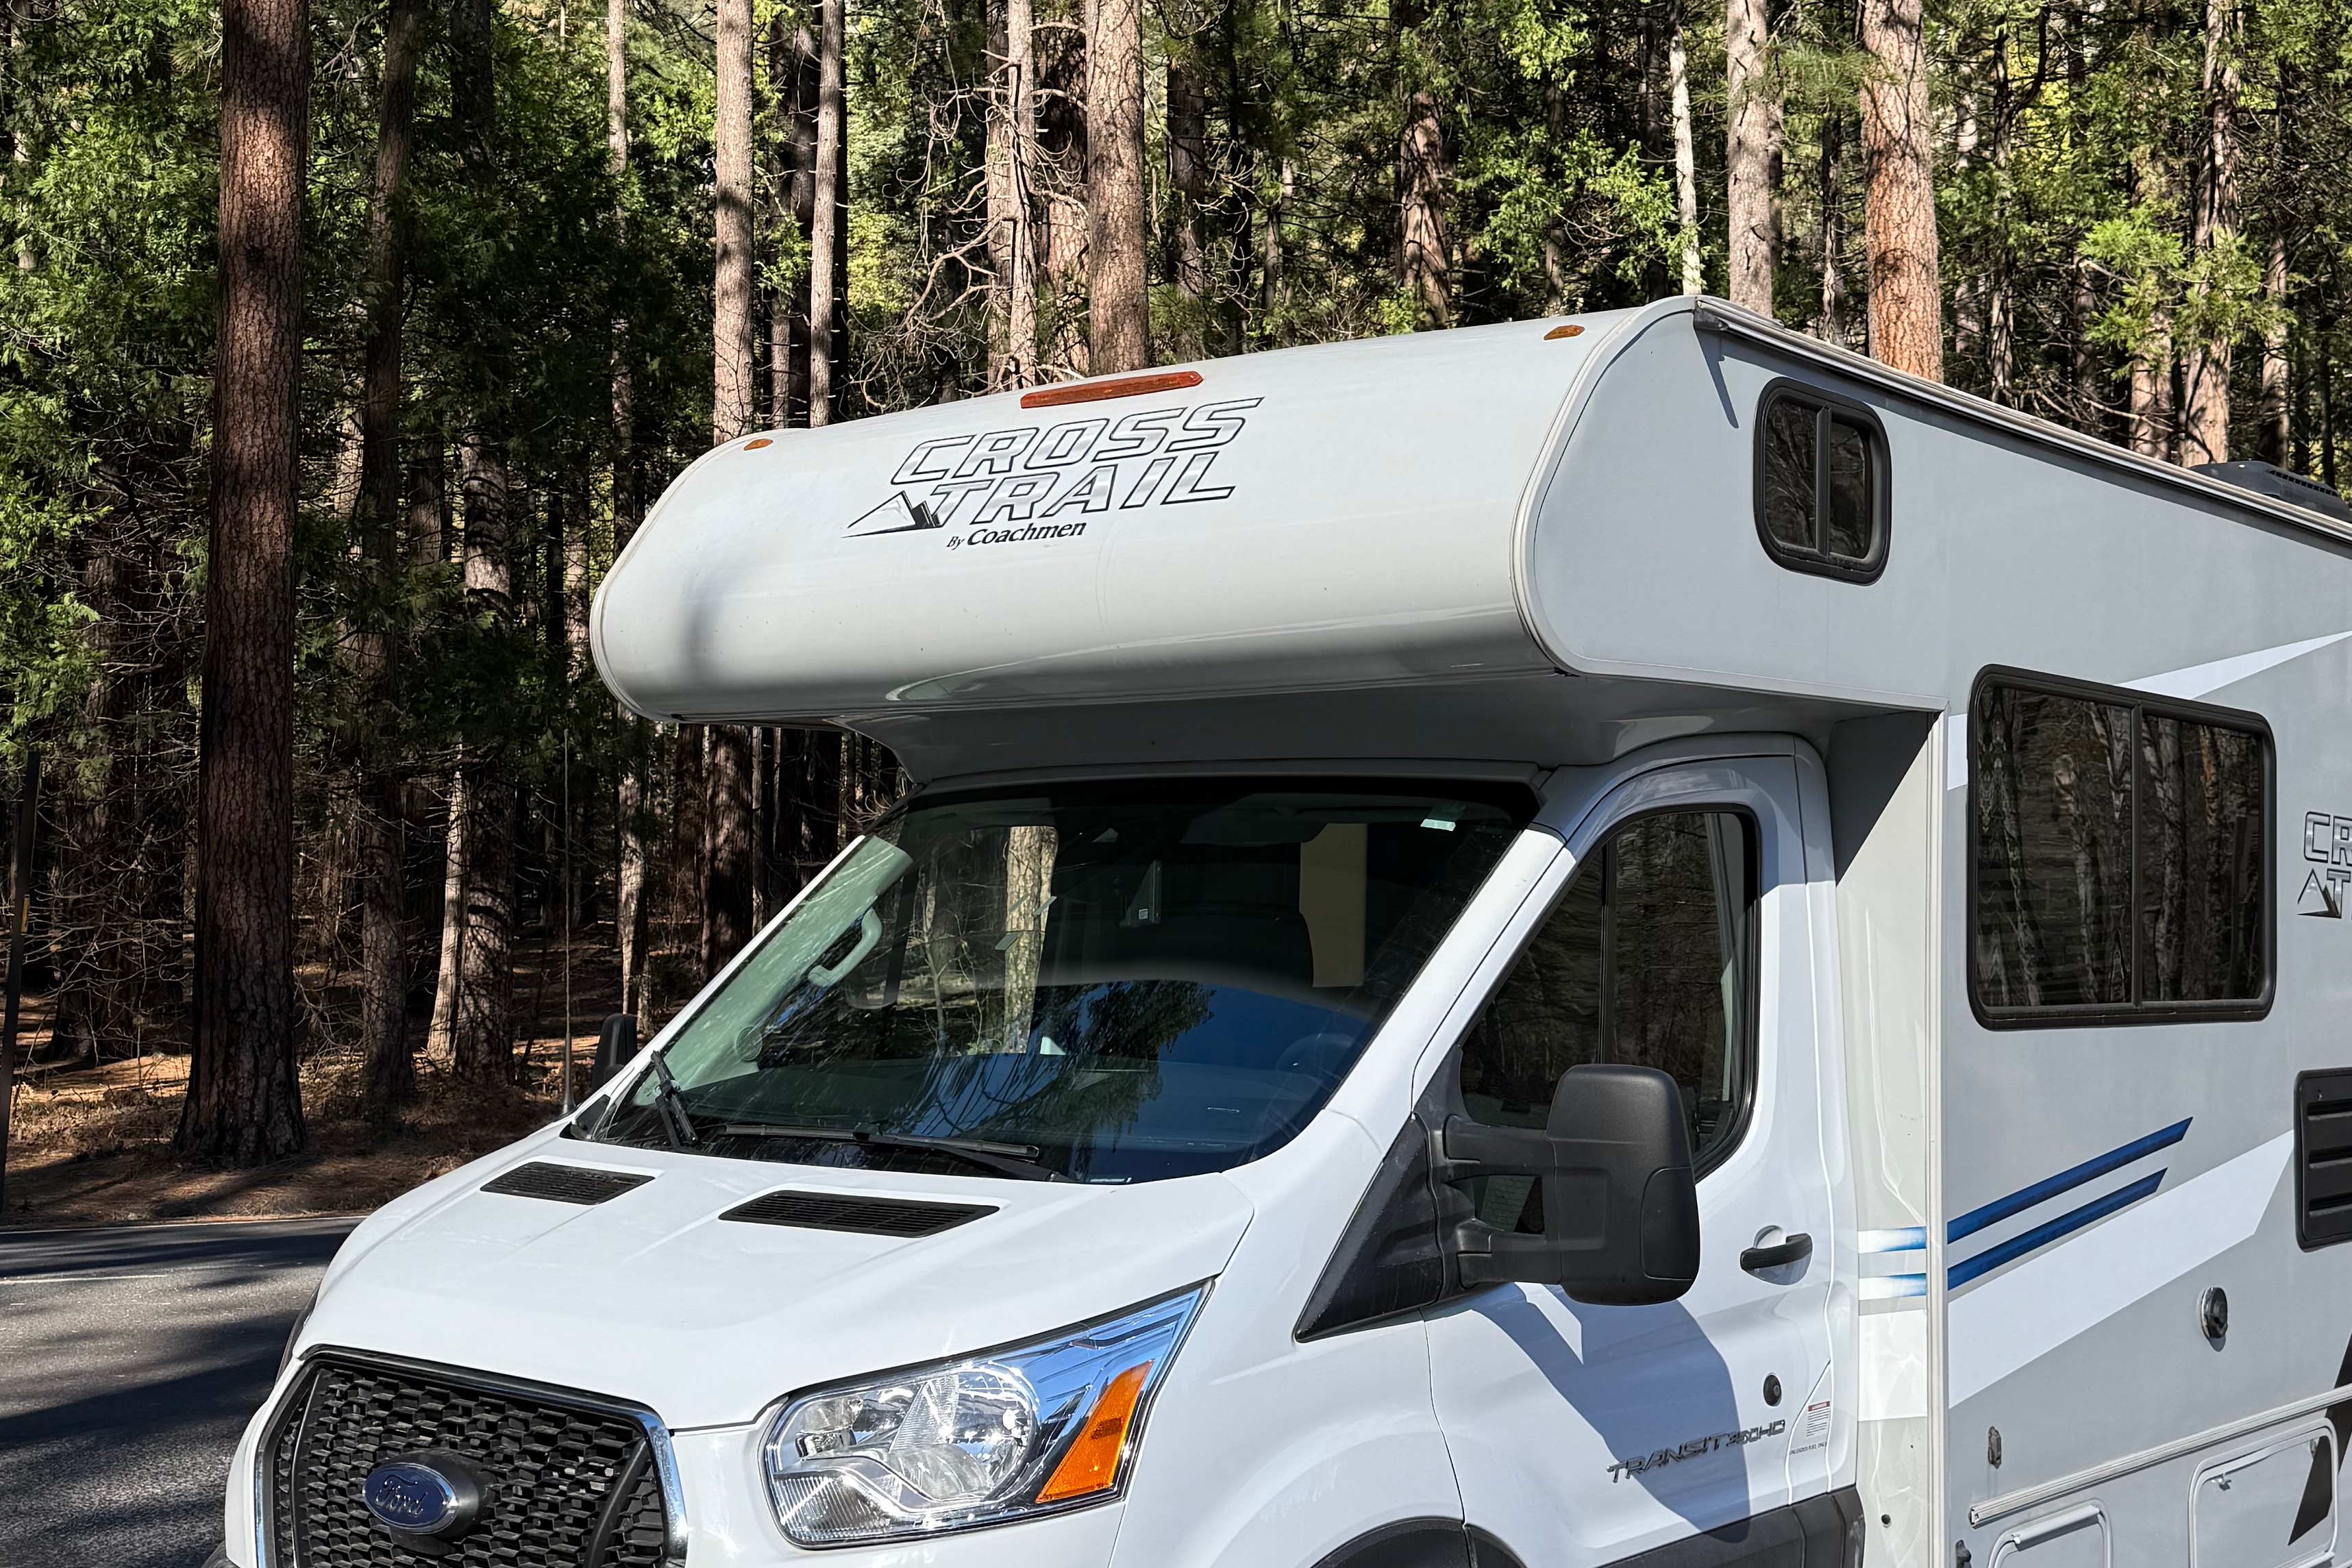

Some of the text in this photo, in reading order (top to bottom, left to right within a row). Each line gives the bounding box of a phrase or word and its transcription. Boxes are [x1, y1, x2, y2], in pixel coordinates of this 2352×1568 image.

[890, 397, 1265, 486] CROSS
[930, 450, 1236, 528] TRAIL
[946, 523, 1087, 551] By Coachmen
[1606, 1432, 1727, 1483] TRANSIT
[375, 1474, 428, 1517] Ford
